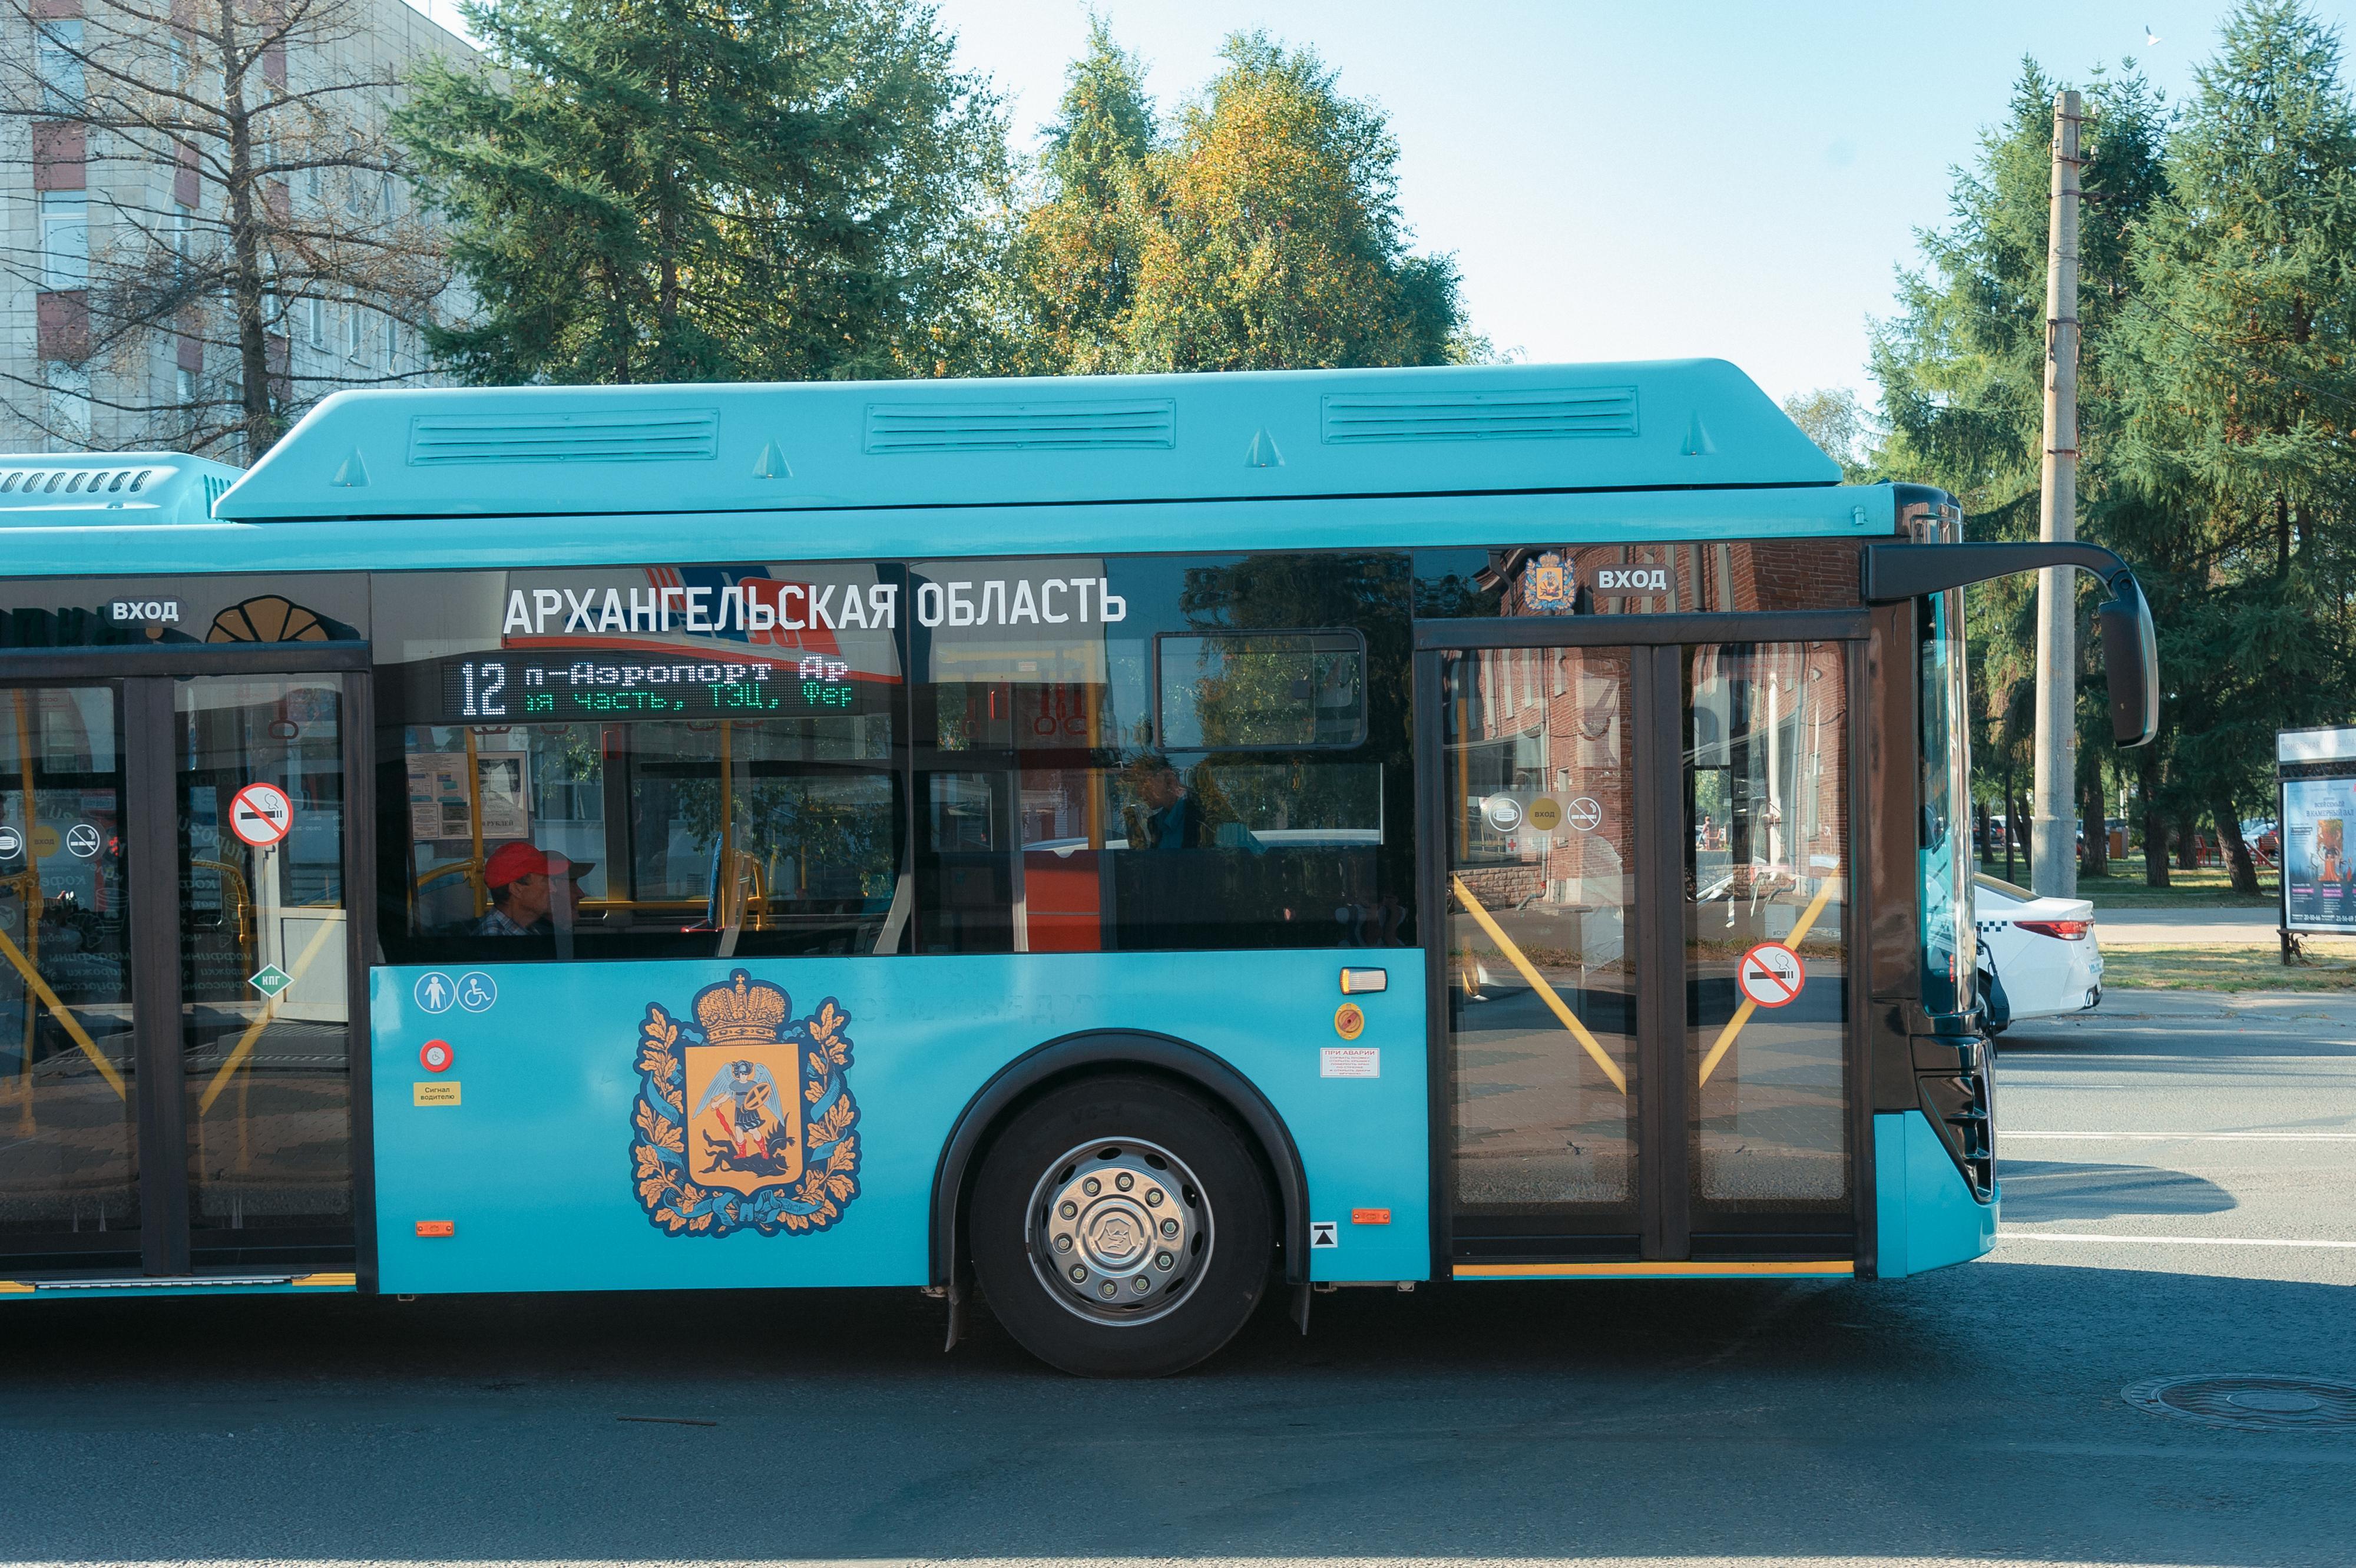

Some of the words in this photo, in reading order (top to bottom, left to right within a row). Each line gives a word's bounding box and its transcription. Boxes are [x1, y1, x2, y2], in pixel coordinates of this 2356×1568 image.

[1599, 570, 1667, 591] ВХОД
[113, 601, 179, 622] ВХОД
[503, 584, 898, 634] АРХАНГЕЛЬСКАЯ
[918, 578, 1126, 627] ОБЛАСТЬ
[799, 653, 849, 684] Ар
[462, 663, 505, 716] 12
[574, 692, 684, 711] часть,
[707, 683, 779, 709] ТЭЦ,
[262, 975, 281, 985] КПГ
